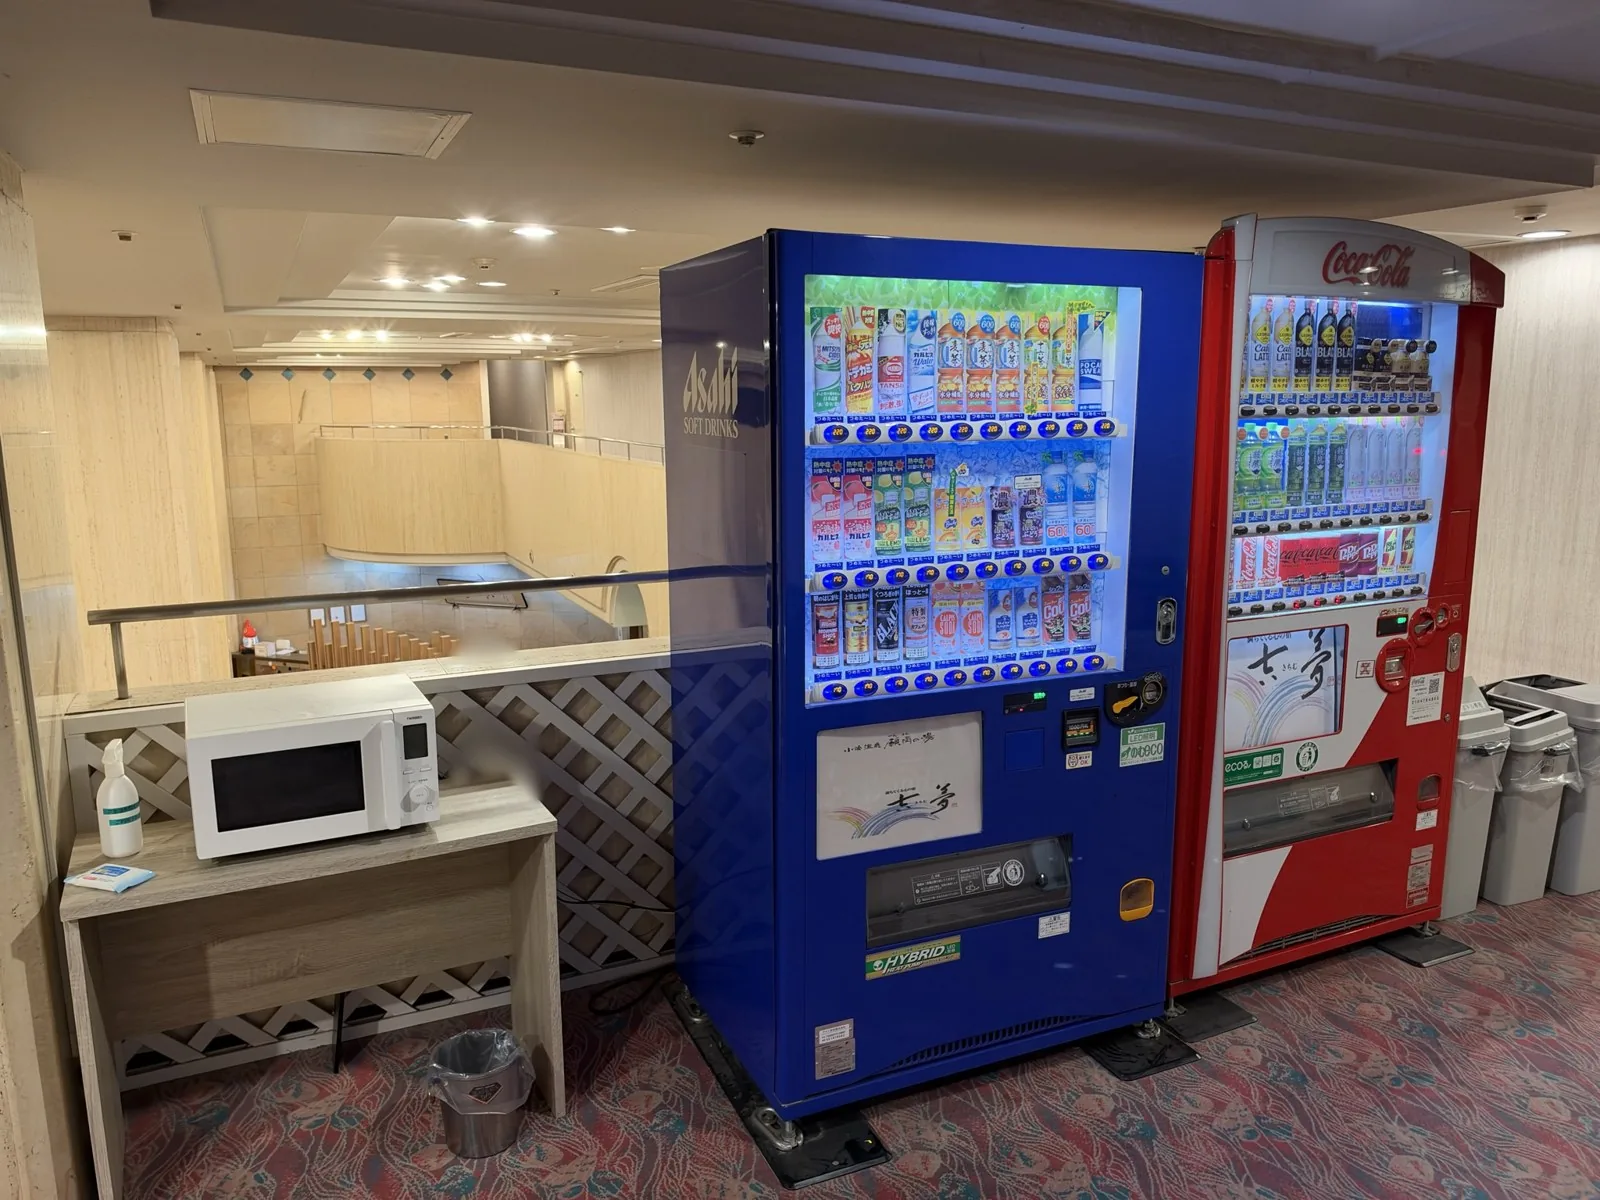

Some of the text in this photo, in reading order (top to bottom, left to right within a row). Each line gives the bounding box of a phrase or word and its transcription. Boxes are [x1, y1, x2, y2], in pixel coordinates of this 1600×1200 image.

[1322, 240, 1415, 288] Coca-Cola
[683, 346, 738, 415] Asahi
[683, 417, 739, 439] SOFT DRINKS
[882, 945, 946, 974] HYBRID
